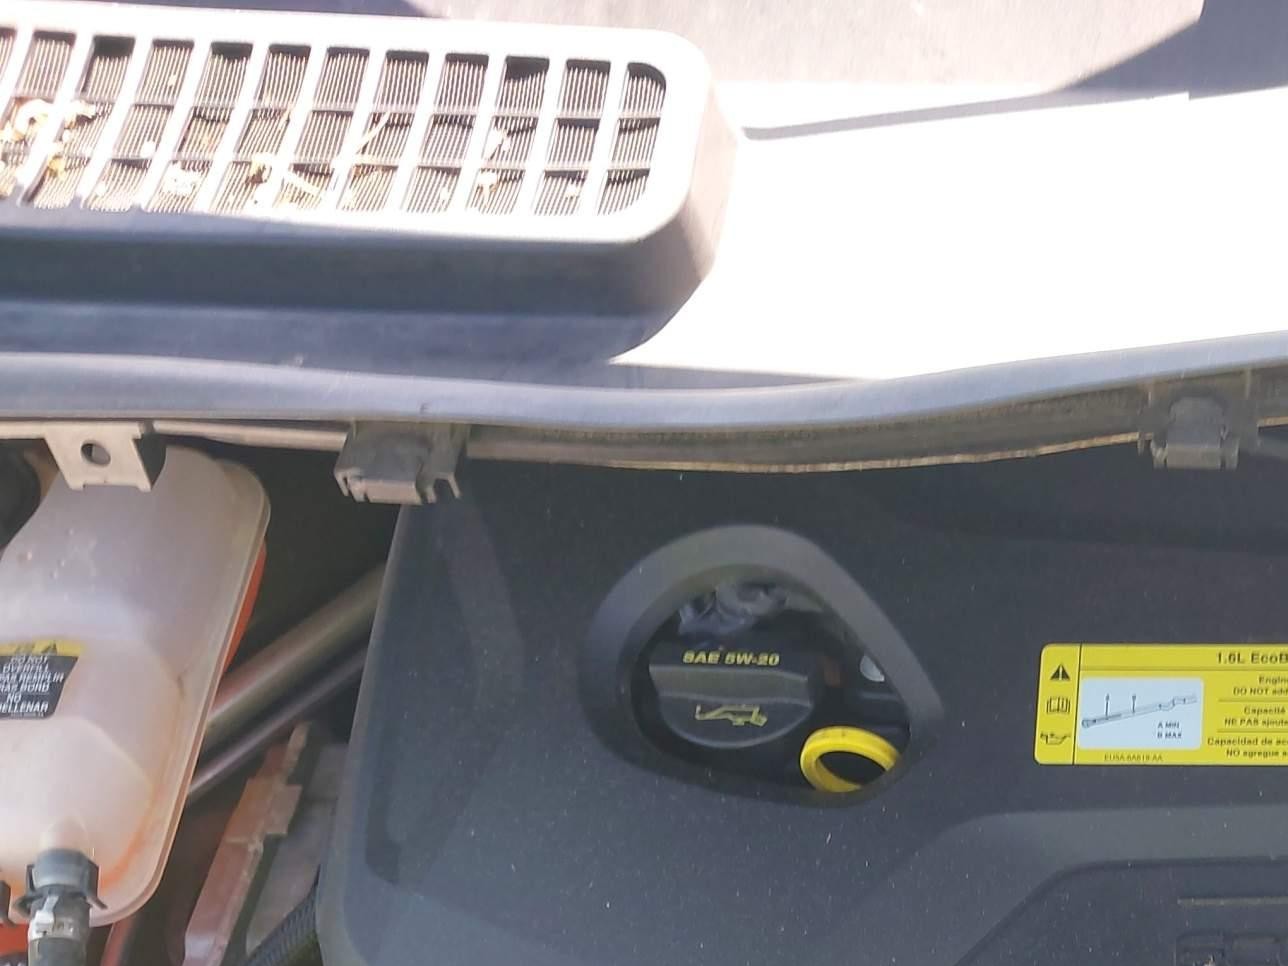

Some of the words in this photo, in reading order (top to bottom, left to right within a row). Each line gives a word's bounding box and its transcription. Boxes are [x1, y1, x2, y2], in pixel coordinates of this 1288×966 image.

[683, 650, 719, 665] SAE
[725, 652, 780, 666] 5W-20
[1217, 651, 1244, 665] 1.6L
[1250, 687, 1268, 695] NOT
[1225, 718, 1238, 726] NE
[1240, 718, 1259, 726] PAS
[1207, 737, 1258, 747] Capacidad
[1226, 749, 1240, 757] NO
